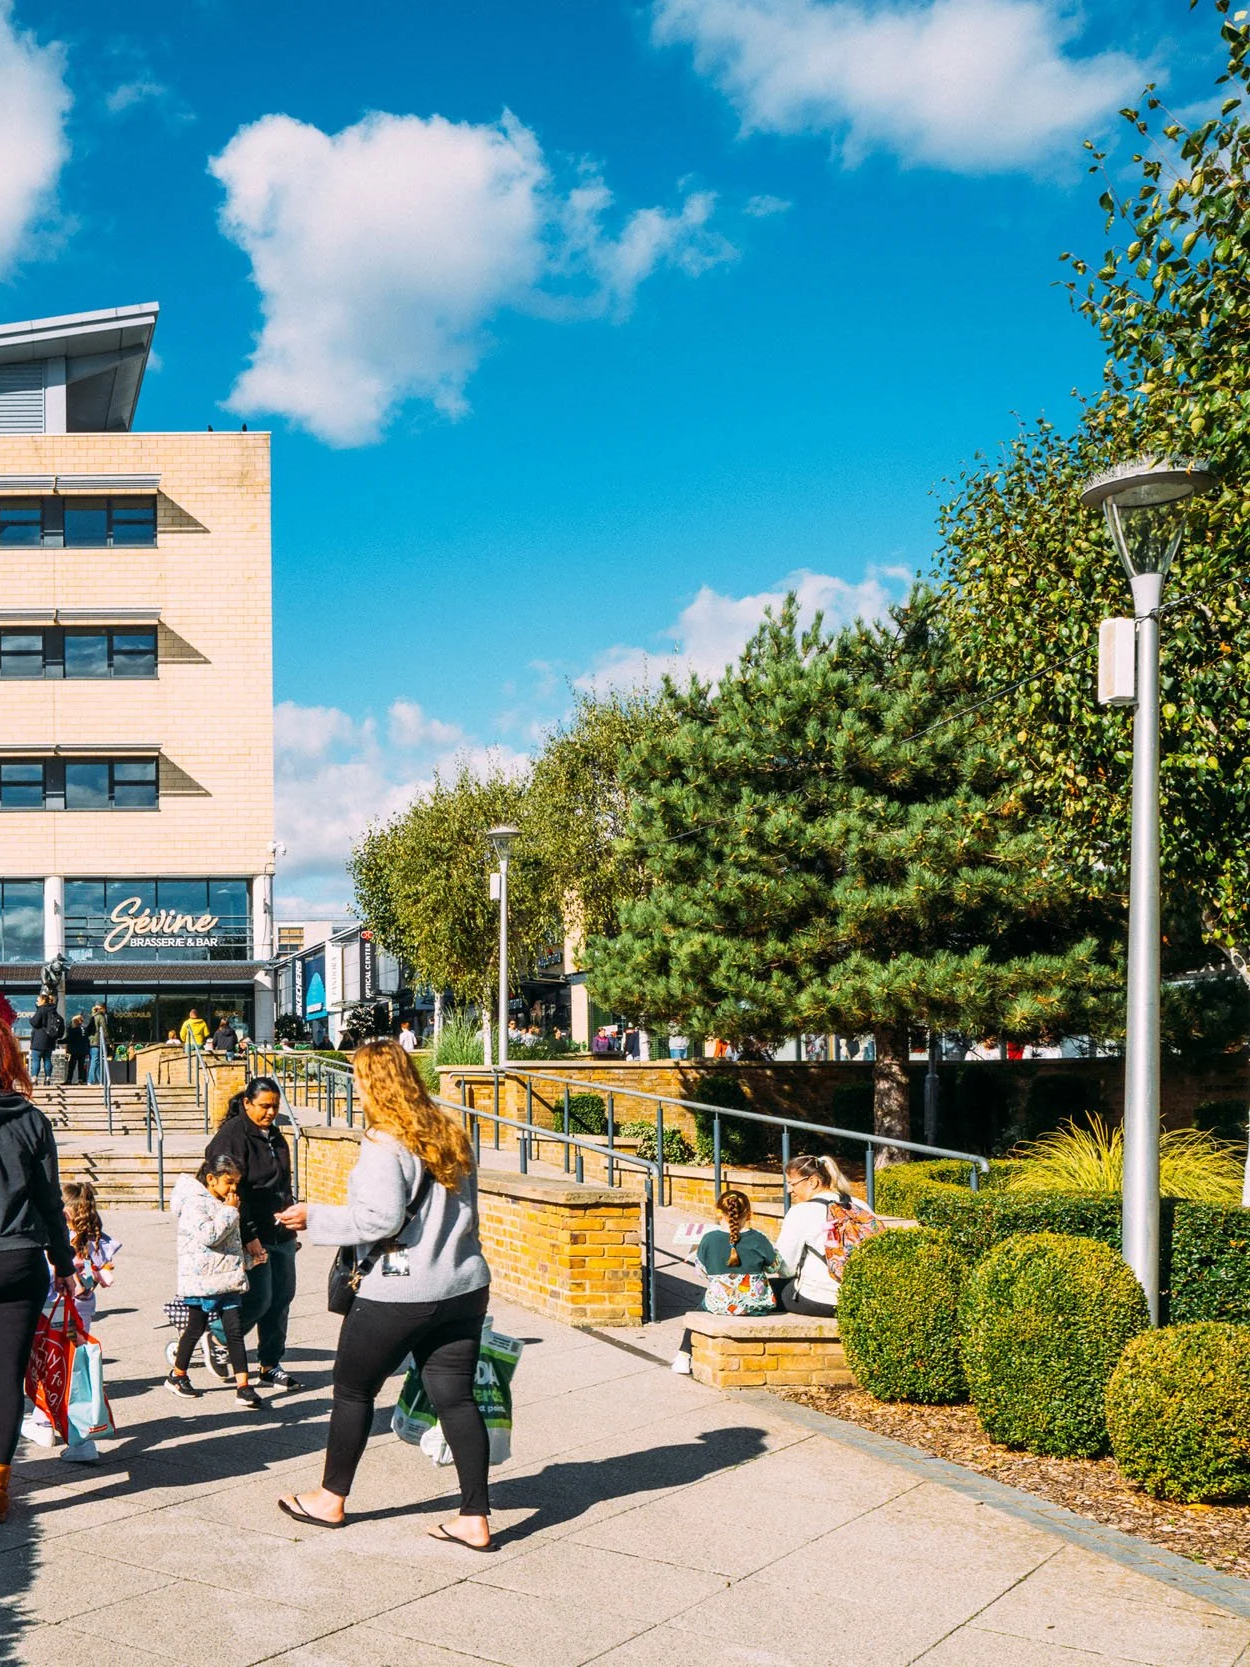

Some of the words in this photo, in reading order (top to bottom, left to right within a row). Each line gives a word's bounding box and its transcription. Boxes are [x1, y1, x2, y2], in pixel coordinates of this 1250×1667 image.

[104, 896, 219, 953] Sévine
[130, 937, 185, 947] BRASSERIE
[186, 938, 195, 947] &
[196, 937, 218, 947] BAR
[295, 959, 303, 1017] SKECHERS
[474, 1360, 500, 1386] DA
